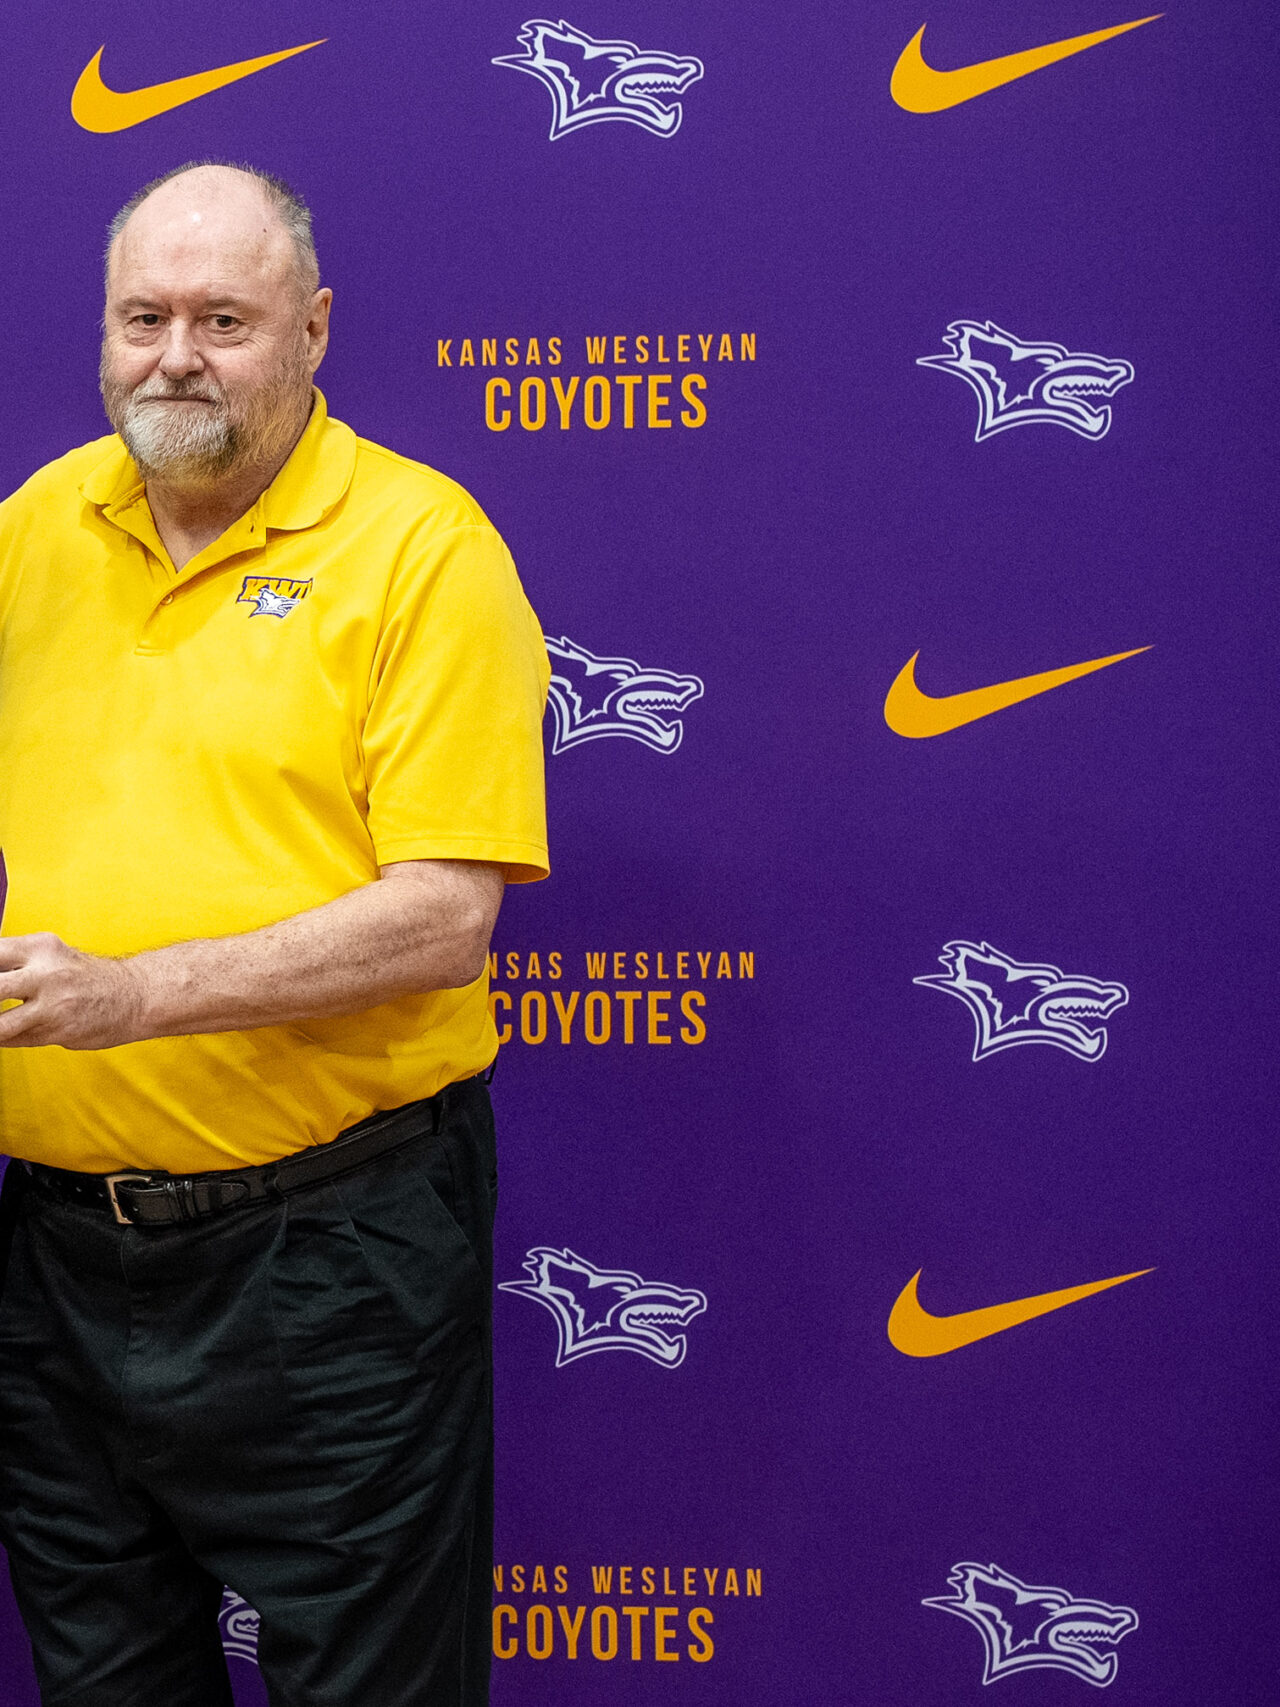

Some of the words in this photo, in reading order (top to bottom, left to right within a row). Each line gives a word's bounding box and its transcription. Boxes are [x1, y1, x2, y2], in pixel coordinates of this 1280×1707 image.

[437, 337, 562, 366] KANSAS
[586, 333, 756, 364] WESLEYAN
[485, 373, 707, 432] COYOTES
[489, 952, 562, 979] NSAS
[586, 951, 754, 979] WESLEYAN
[489, 990, 707, 1045] COYOTES
[493, 1565, 568, 1593] NSAS
[592, 1566, 762, 1596] WESLEYAN
[492, 1604, 714, 1663] COYOTES
